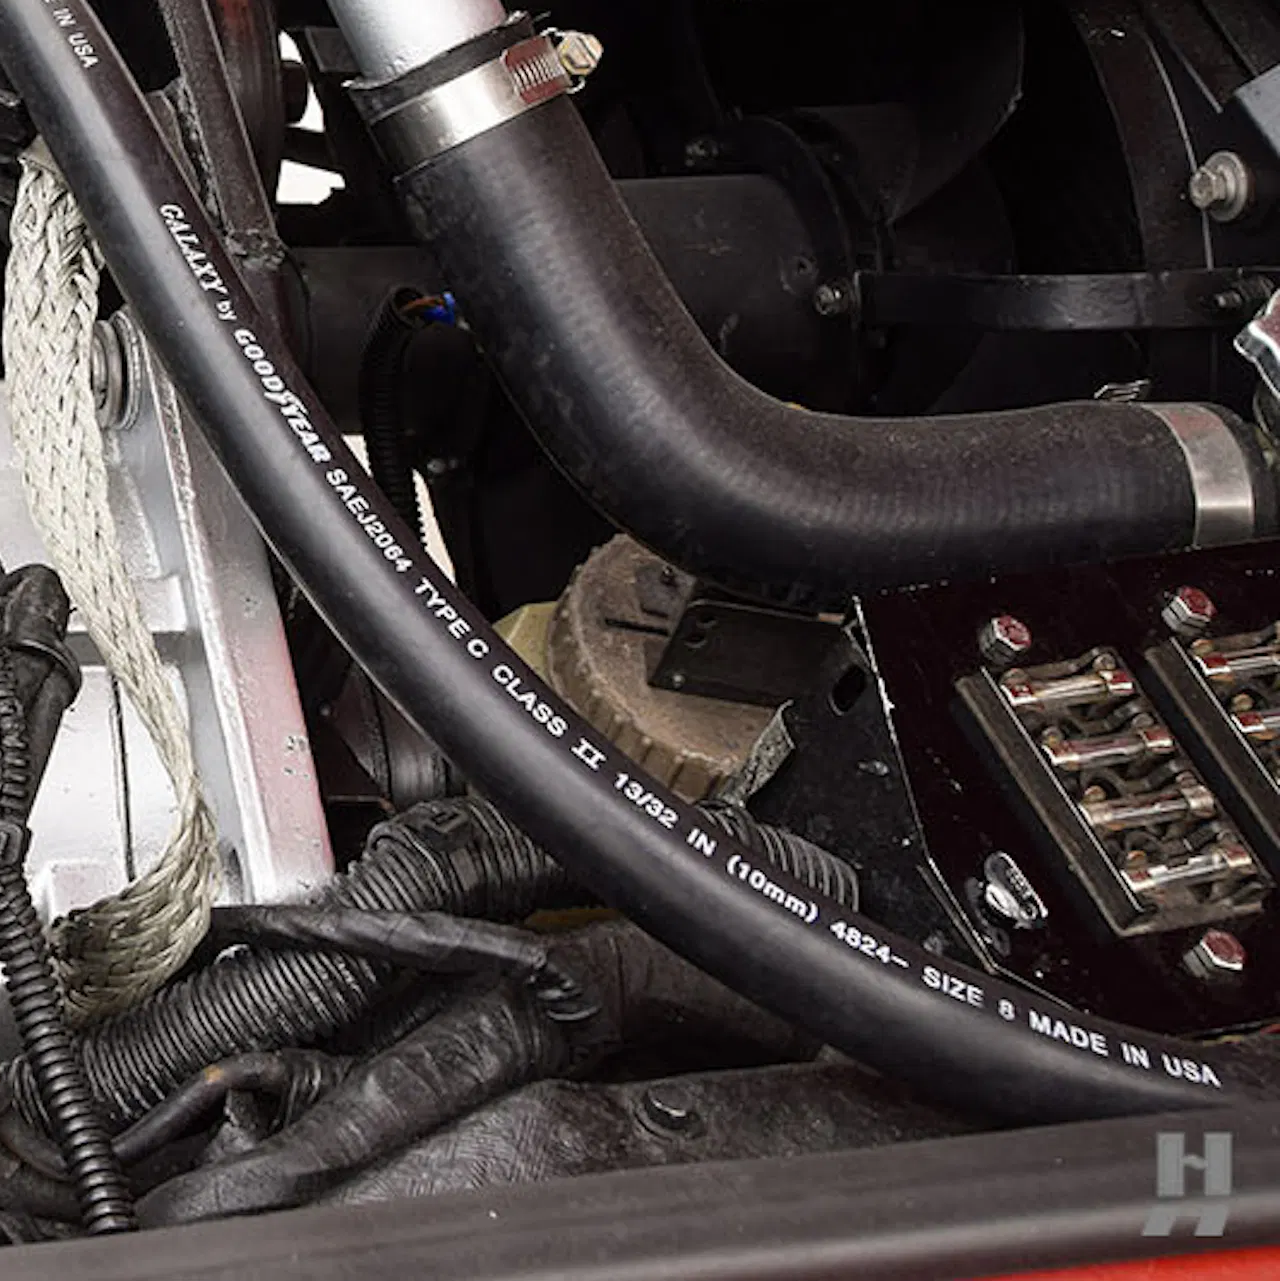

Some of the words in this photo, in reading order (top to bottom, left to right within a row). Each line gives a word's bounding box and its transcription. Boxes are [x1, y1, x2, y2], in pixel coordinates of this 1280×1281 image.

[68, 32, 100, 69] USA
[159, 202, 229, 294] GALAXY
[215, 298, 237, 322] by
[233, 327, 332, 465] GOODYEAR
[325, 468, 413, 573] SAEJ2064
[413, 578, 470, 639] TYPE
[466, 637, 490, 660] C
[491, 664, 567, 738] CLASS
[571, 735, 607, 771] II
[613, 771, 679, 829] 13/32
[685, 827, 717, 859] IN
[725, 853, 819, 924] (10mm)
[920, 965, 985, 1007] SIZE
[998, 998, 1017, 1021] 8
[1028, 1013, 1110, 1057] MADE
[1120, 1043, 1151, 1071] IN
[1163, 1055, 1222, 1089] USA
